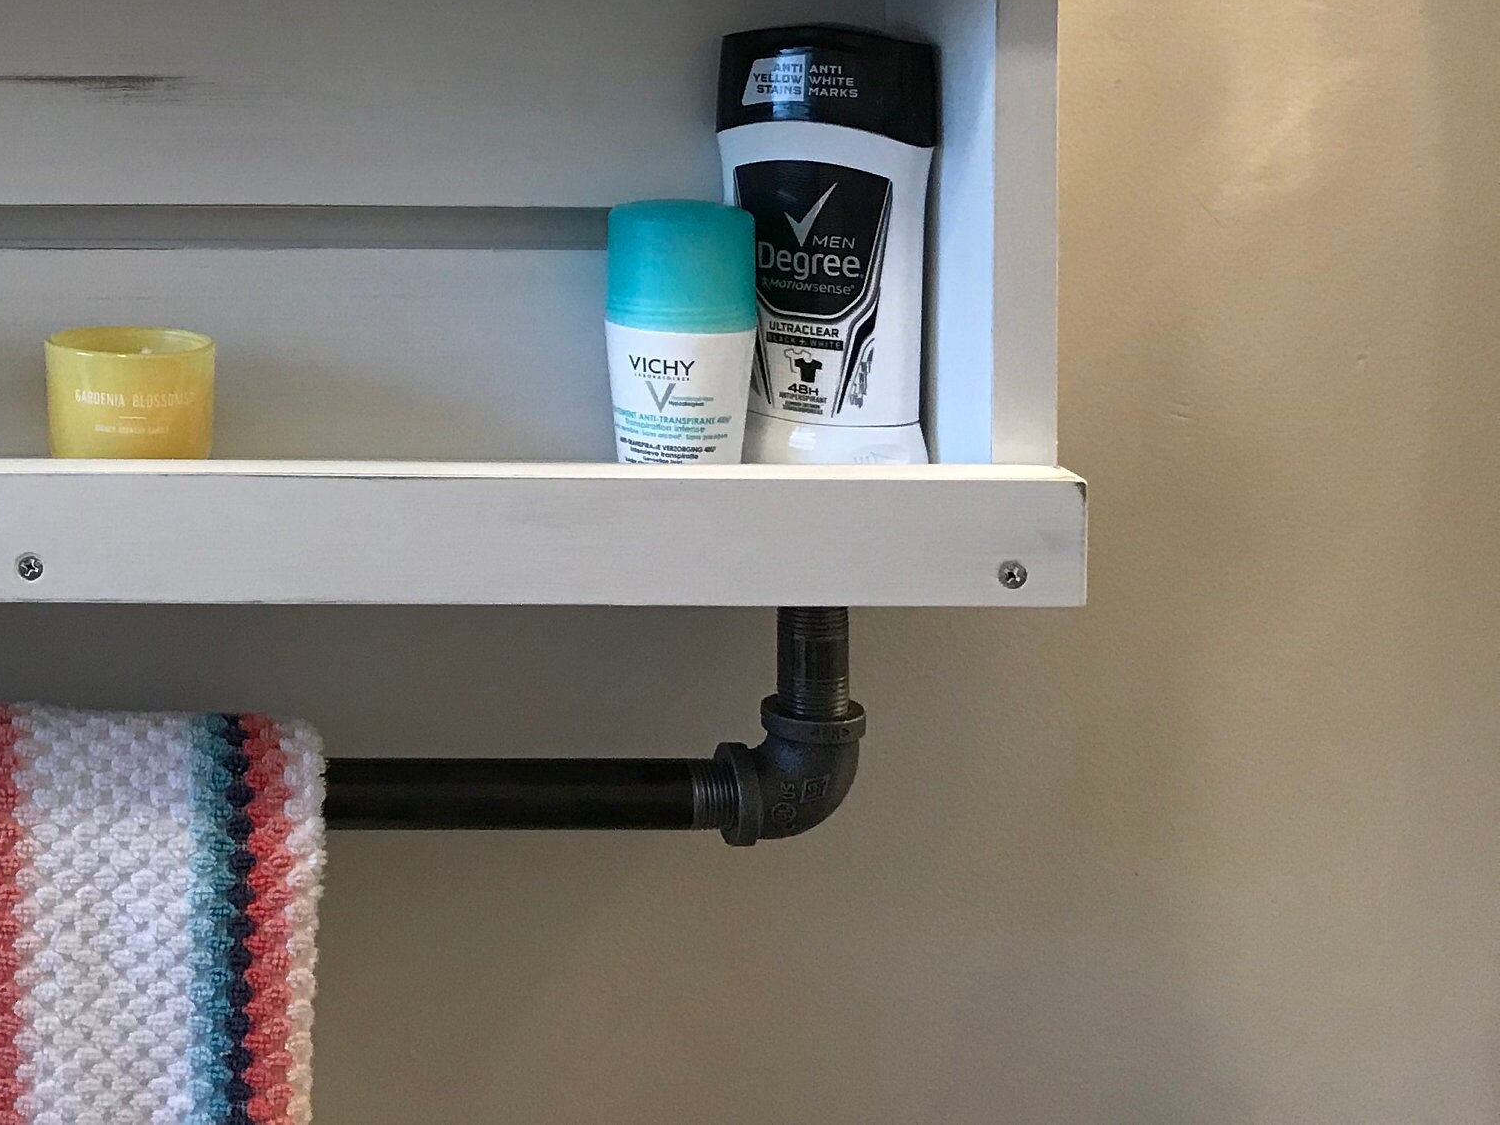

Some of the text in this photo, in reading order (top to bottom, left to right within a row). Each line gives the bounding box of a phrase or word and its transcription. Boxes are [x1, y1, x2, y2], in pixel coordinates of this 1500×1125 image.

[773, 63, 802, 73] ANTI
[809, 64, 842, 74] ANTI
[753, 72, 802, 84] YELLOW
[809, 76, 854, 87] WHITE
[756, 84, 802, 95] STAINS
[808, 87, 858, 98] MARKS
[812, 235, 856, 249] MEN
[758, 241, 861, 280] Degree
[769, 321, 839, 338] ULTRACLEAR
[810, 338, 841, 350] WHITE
[629, 355, 695, 376] VICHY
[788, 383, 819, 396] 48H
[74, 389, 190, 407] GARDENIA BLOSSOMS
[638, 413, 715, 425] ANTI-TRANSPIRANT
[674, 425, 705, 433] intense
